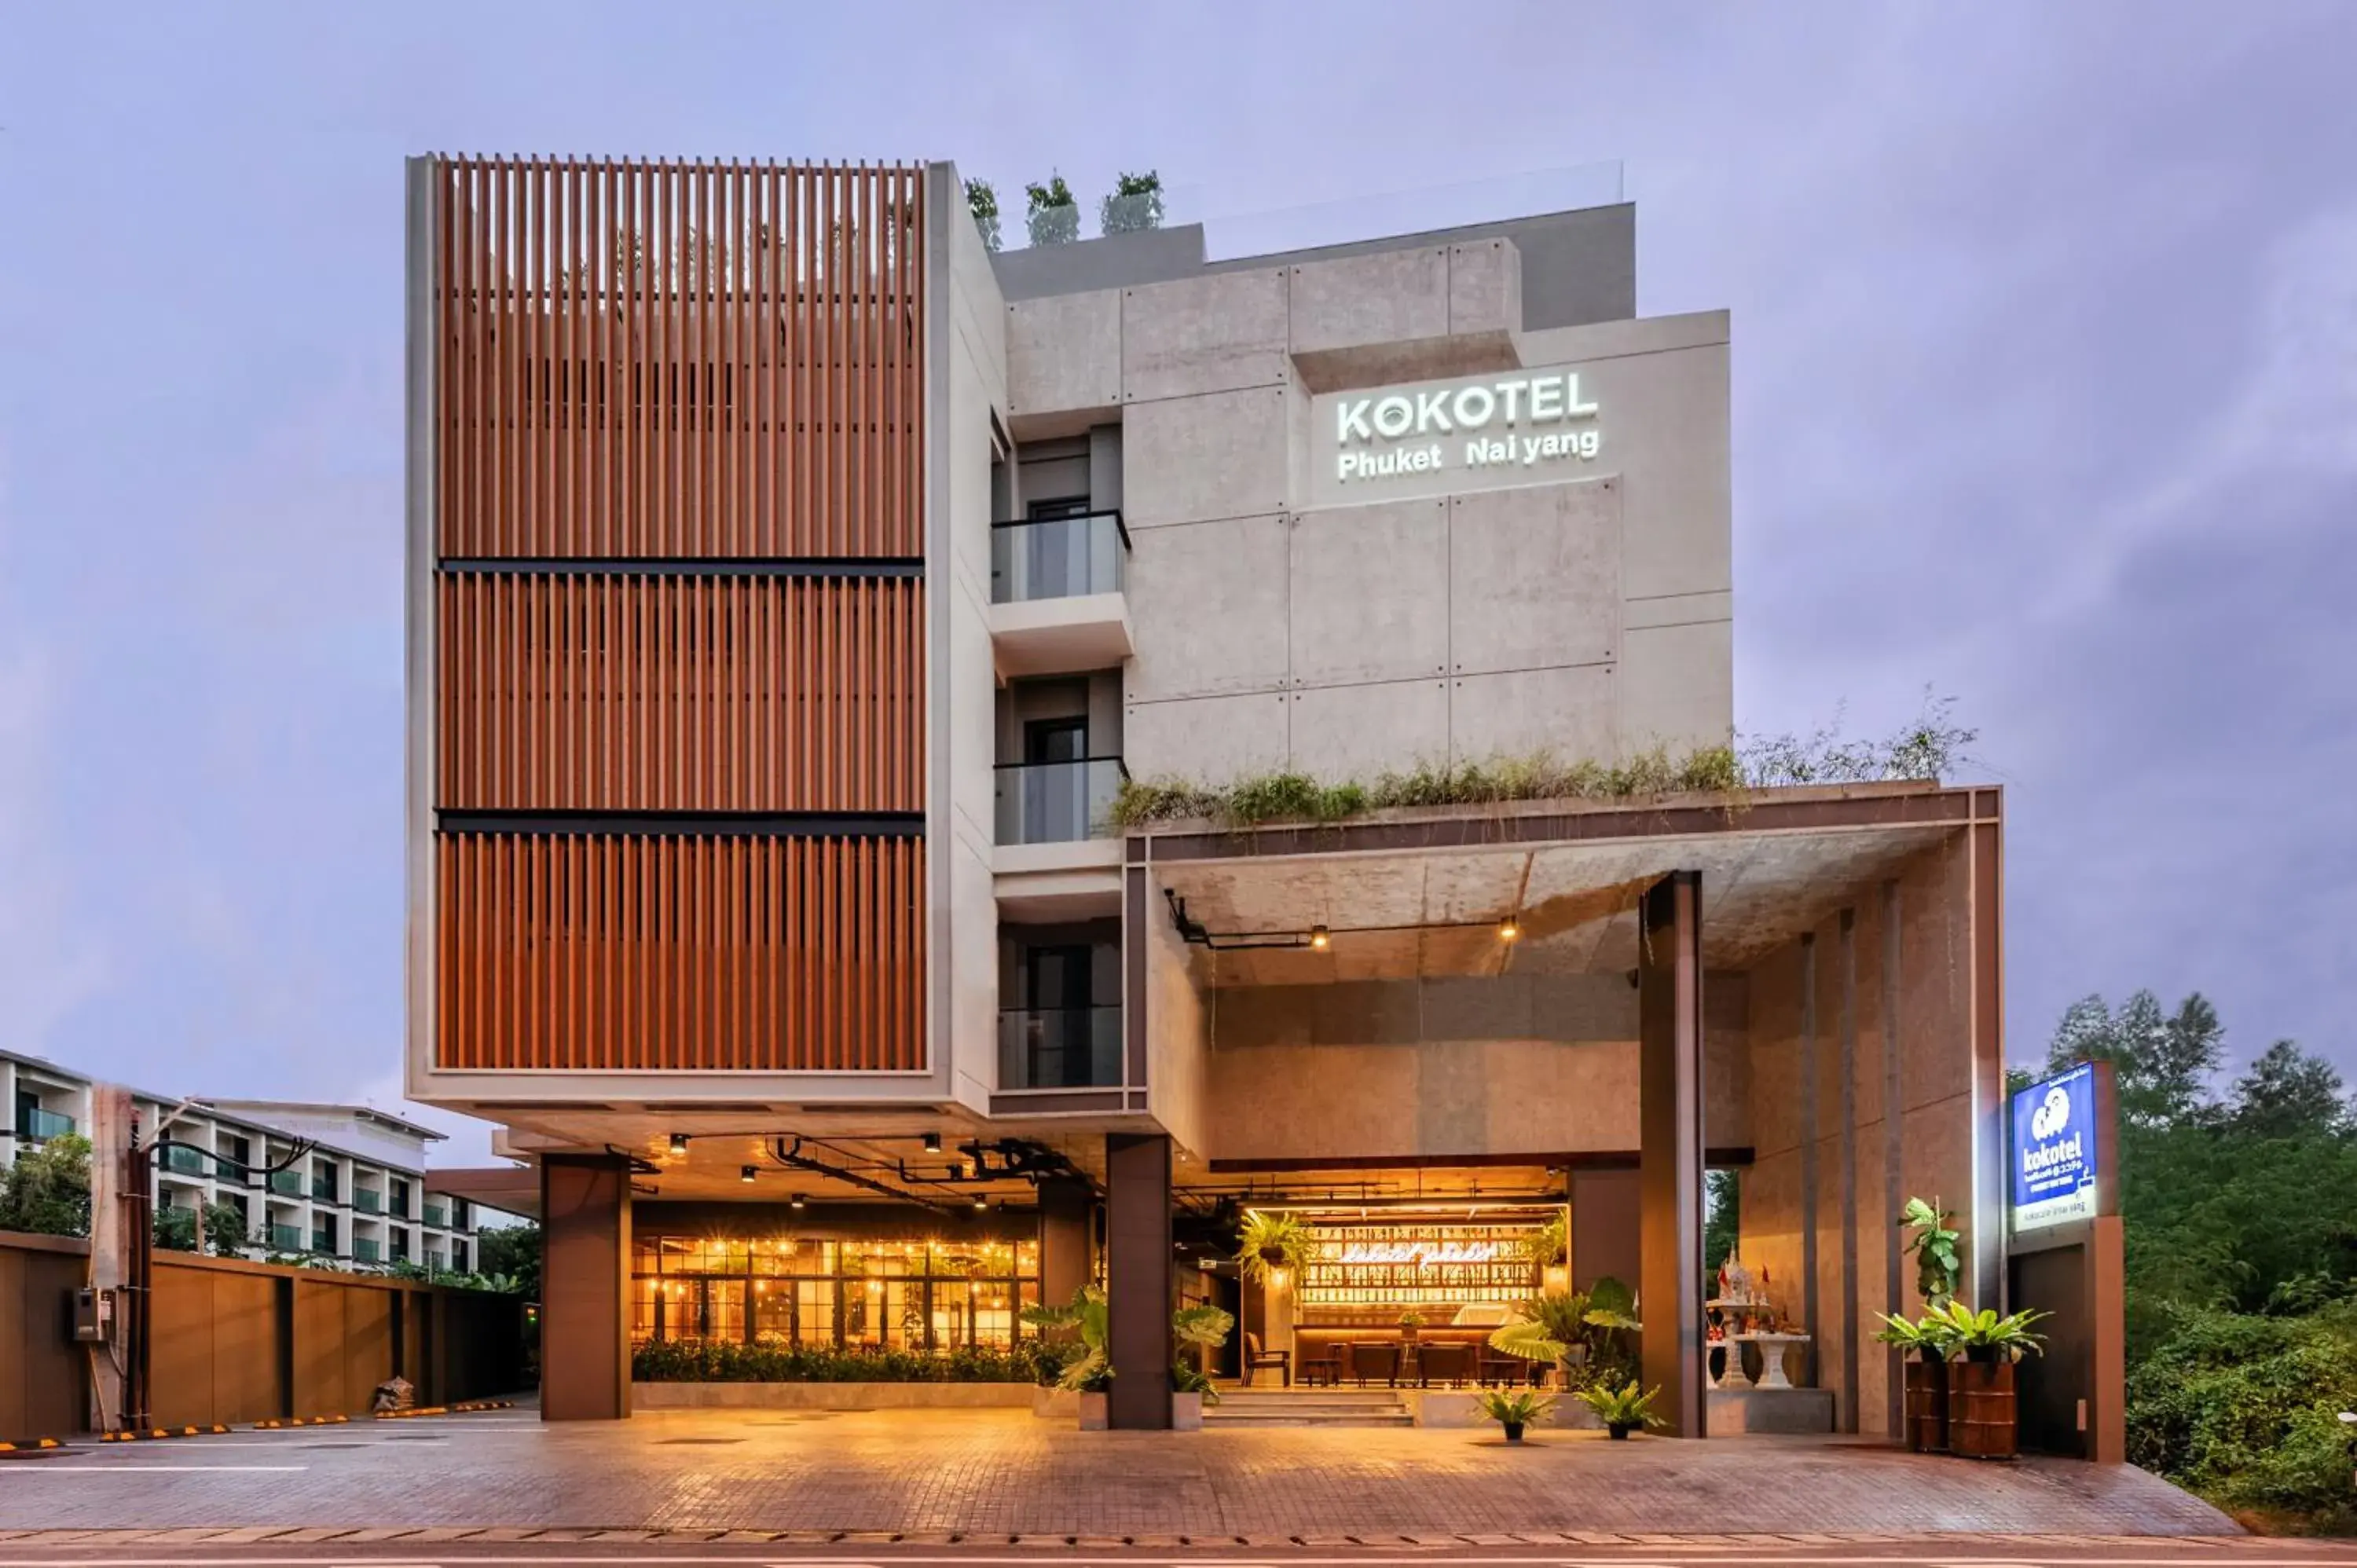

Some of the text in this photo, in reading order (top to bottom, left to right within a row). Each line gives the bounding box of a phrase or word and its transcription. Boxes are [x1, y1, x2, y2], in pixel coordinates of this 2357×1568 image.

[1337, 373, 1599, 441] KOKOTEL
[1337, 430, 1600, 480] Phuket Nai yang
[2024, 1131, 2083, 1173] kokotel
